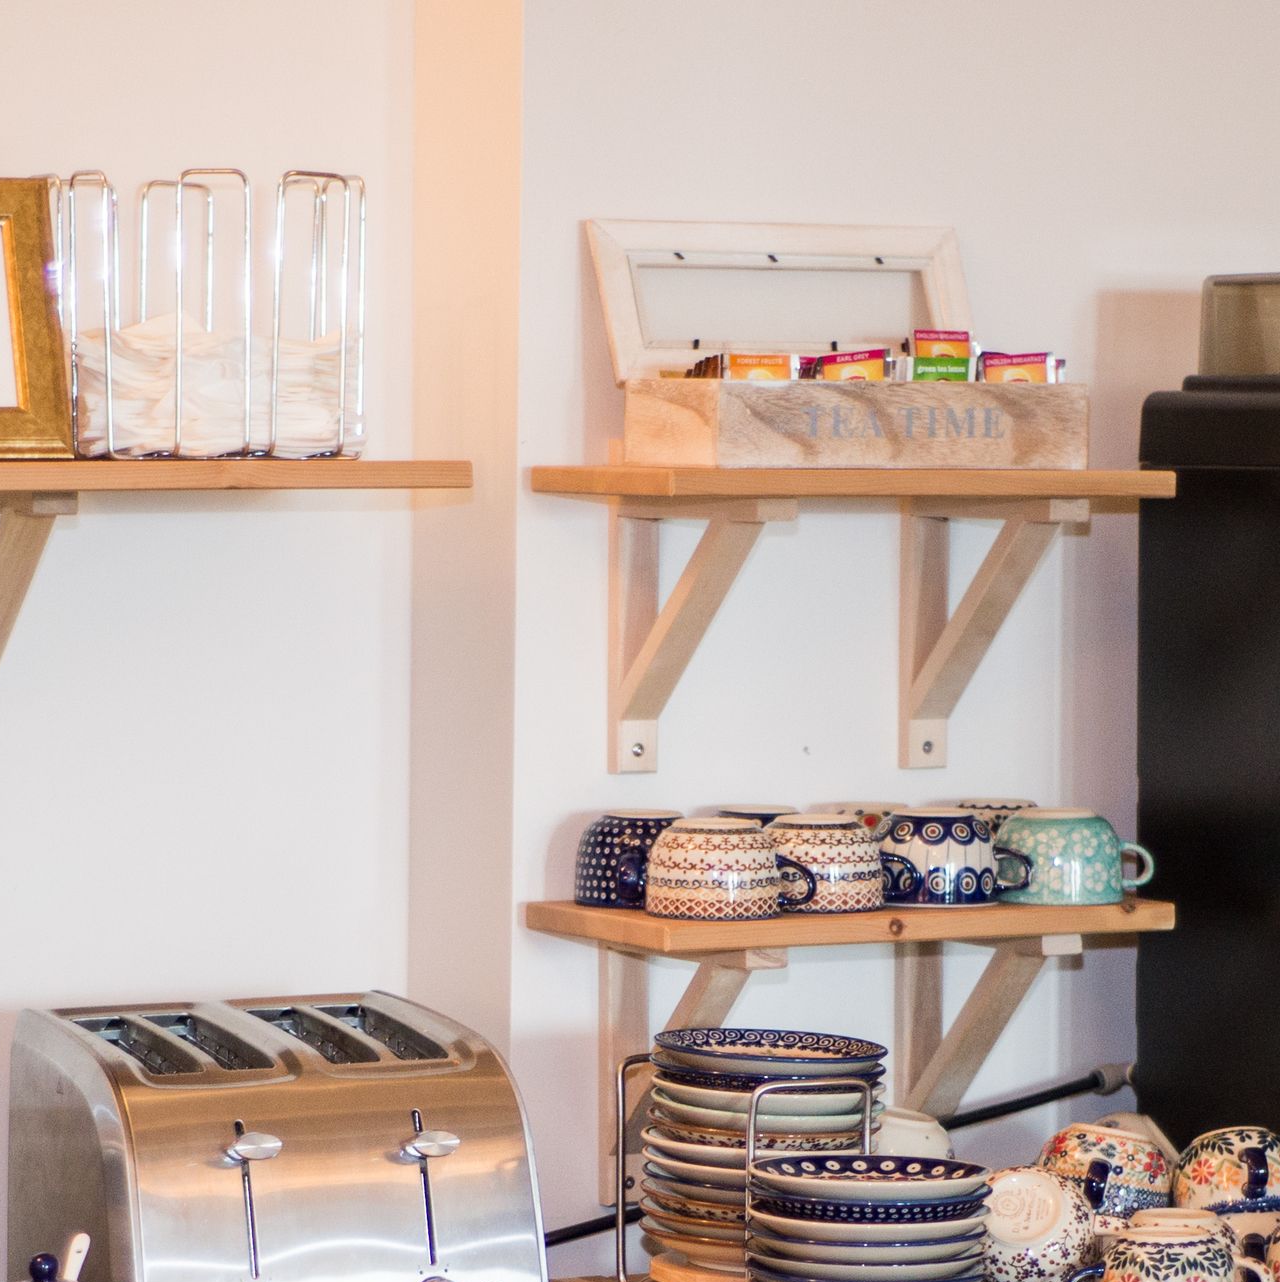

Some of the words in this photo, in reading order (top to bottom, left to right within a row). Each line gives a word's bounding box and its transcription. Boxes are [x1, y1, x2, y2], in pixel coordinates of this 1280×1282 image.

[836, 354, 853, 363] EARL
[800, 405, 885, 439] TEA
[897, 404, 1006, 440] TIME
